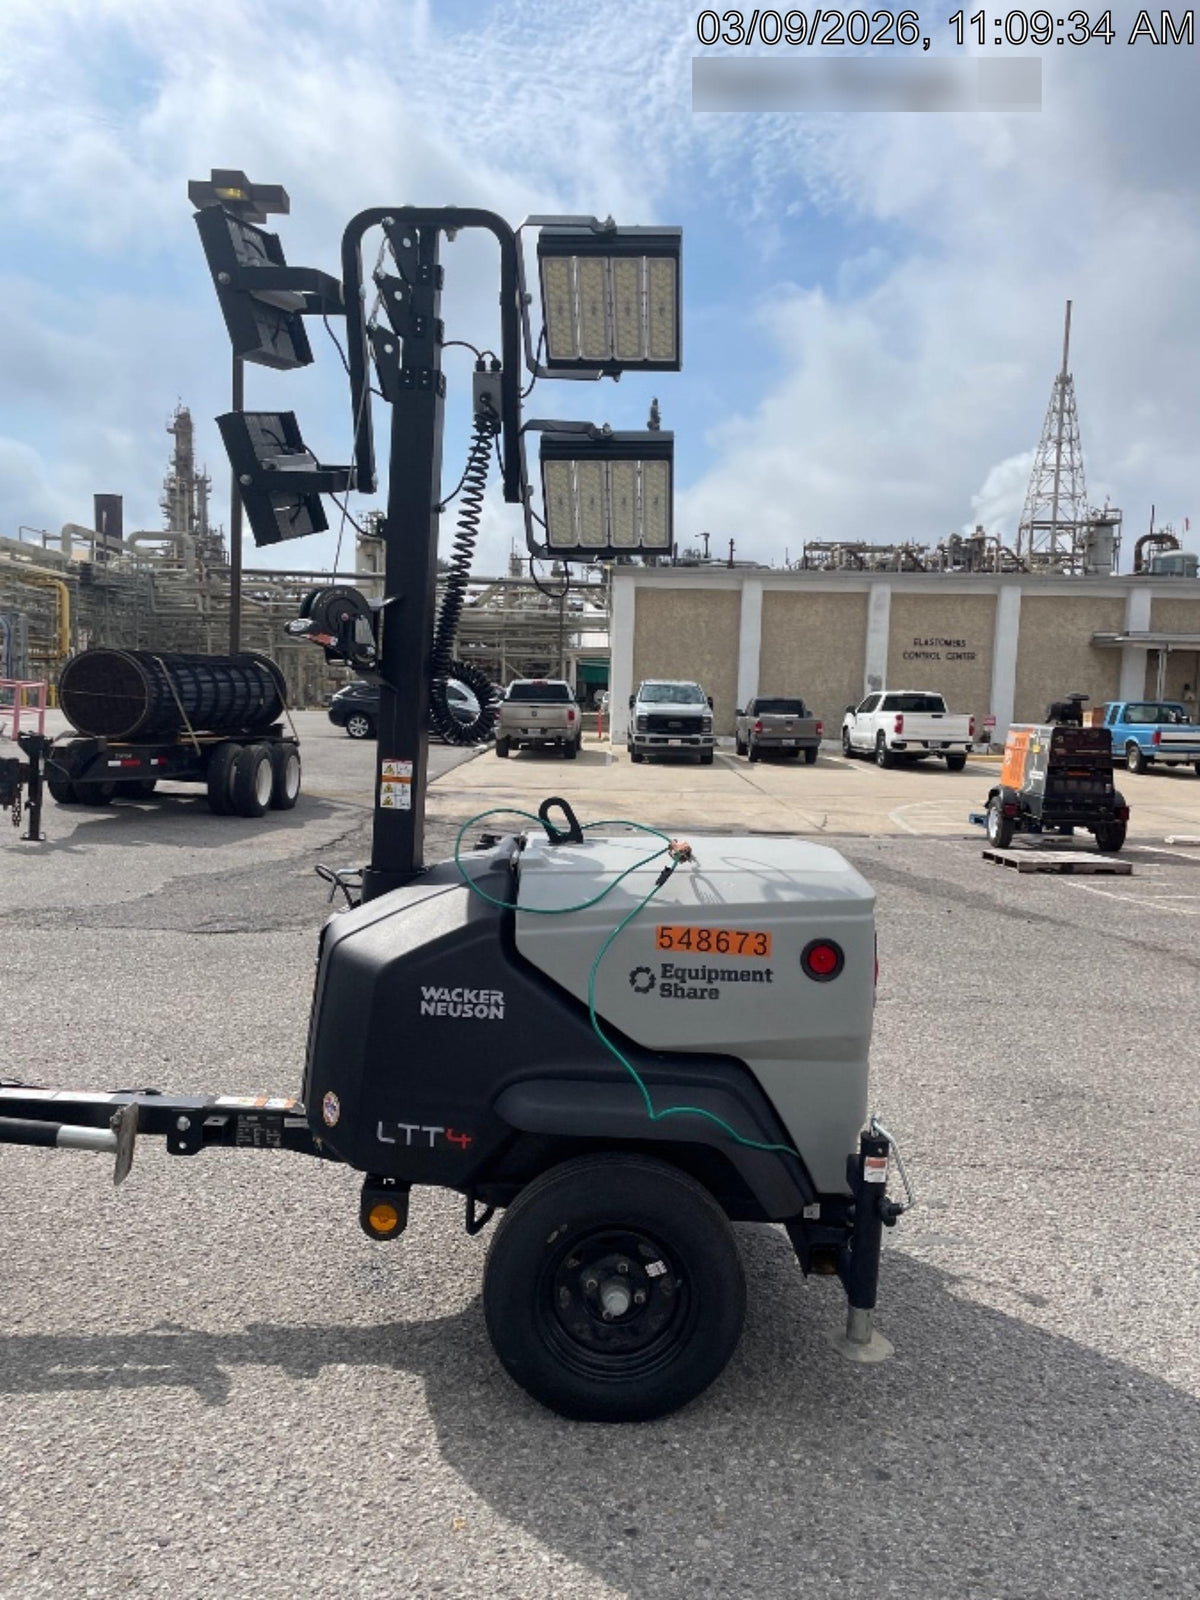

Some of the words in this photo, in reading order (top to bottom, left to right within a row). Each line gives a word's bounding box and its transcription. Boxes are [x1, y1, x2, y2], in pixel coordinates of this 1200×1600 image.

[902, 650, 941, 660] CONTROL
[659, 926, 768, 956] 548673
[660, 963, 773, 985] Equipment
[420, 986, 505, 1005] WACKER
[659, 982, 720, 1000] Share
[420, 1000, 505, 1019] NEUSON
[376, 1120, 472, 1150] LTT4
